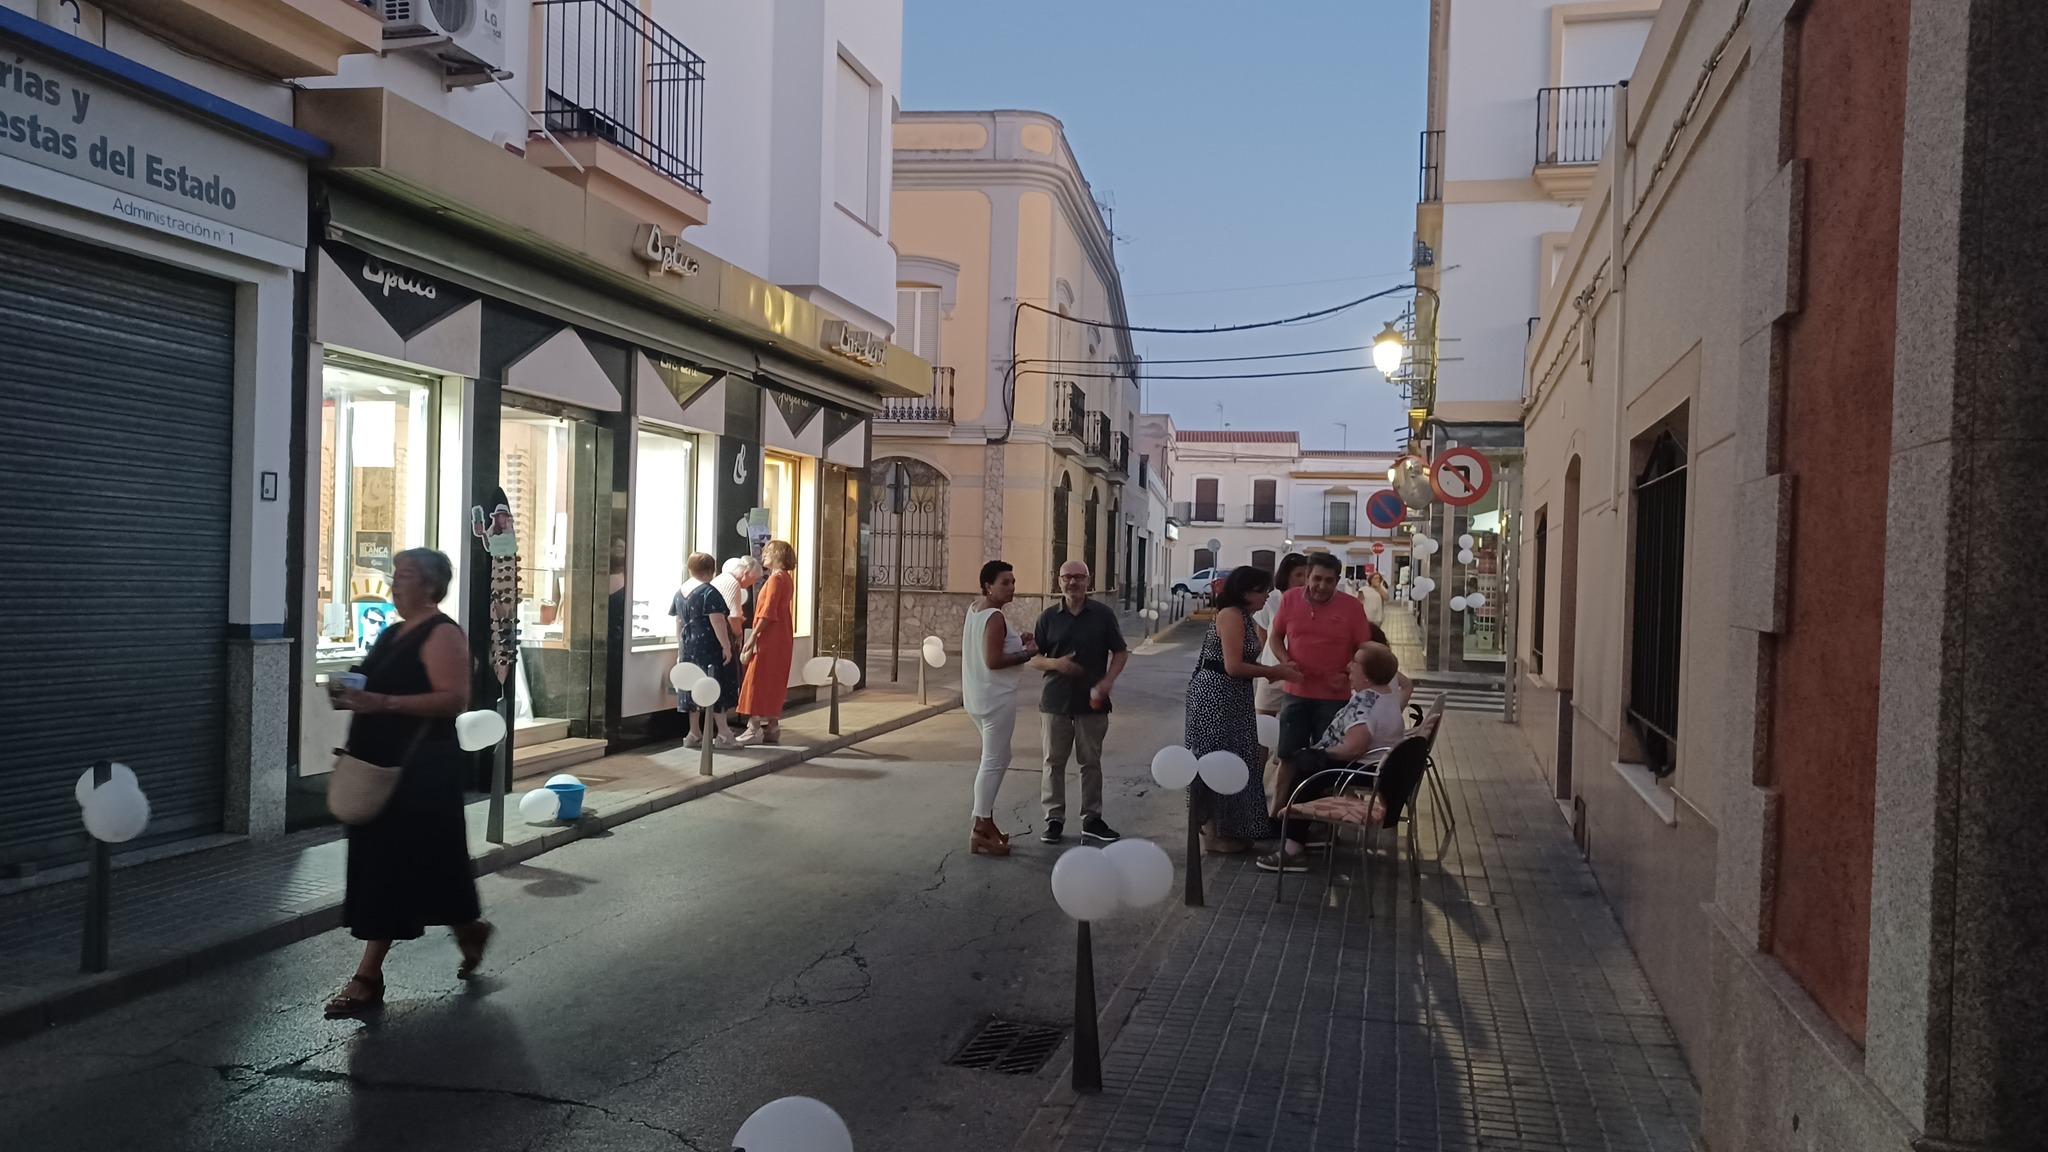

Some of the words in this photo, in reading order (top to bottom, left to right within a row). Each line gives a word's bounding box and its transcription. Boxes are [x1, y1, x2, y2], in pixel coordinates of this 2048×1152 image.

[484, 9, 498, 28] LG
[72, 88, 90, 125] y
[89, 135, 135, 179] del
[146, 153, 237, 211] Estado
[113, 197, 210, 239] Administración
[228, 231, 235, 246] 1
